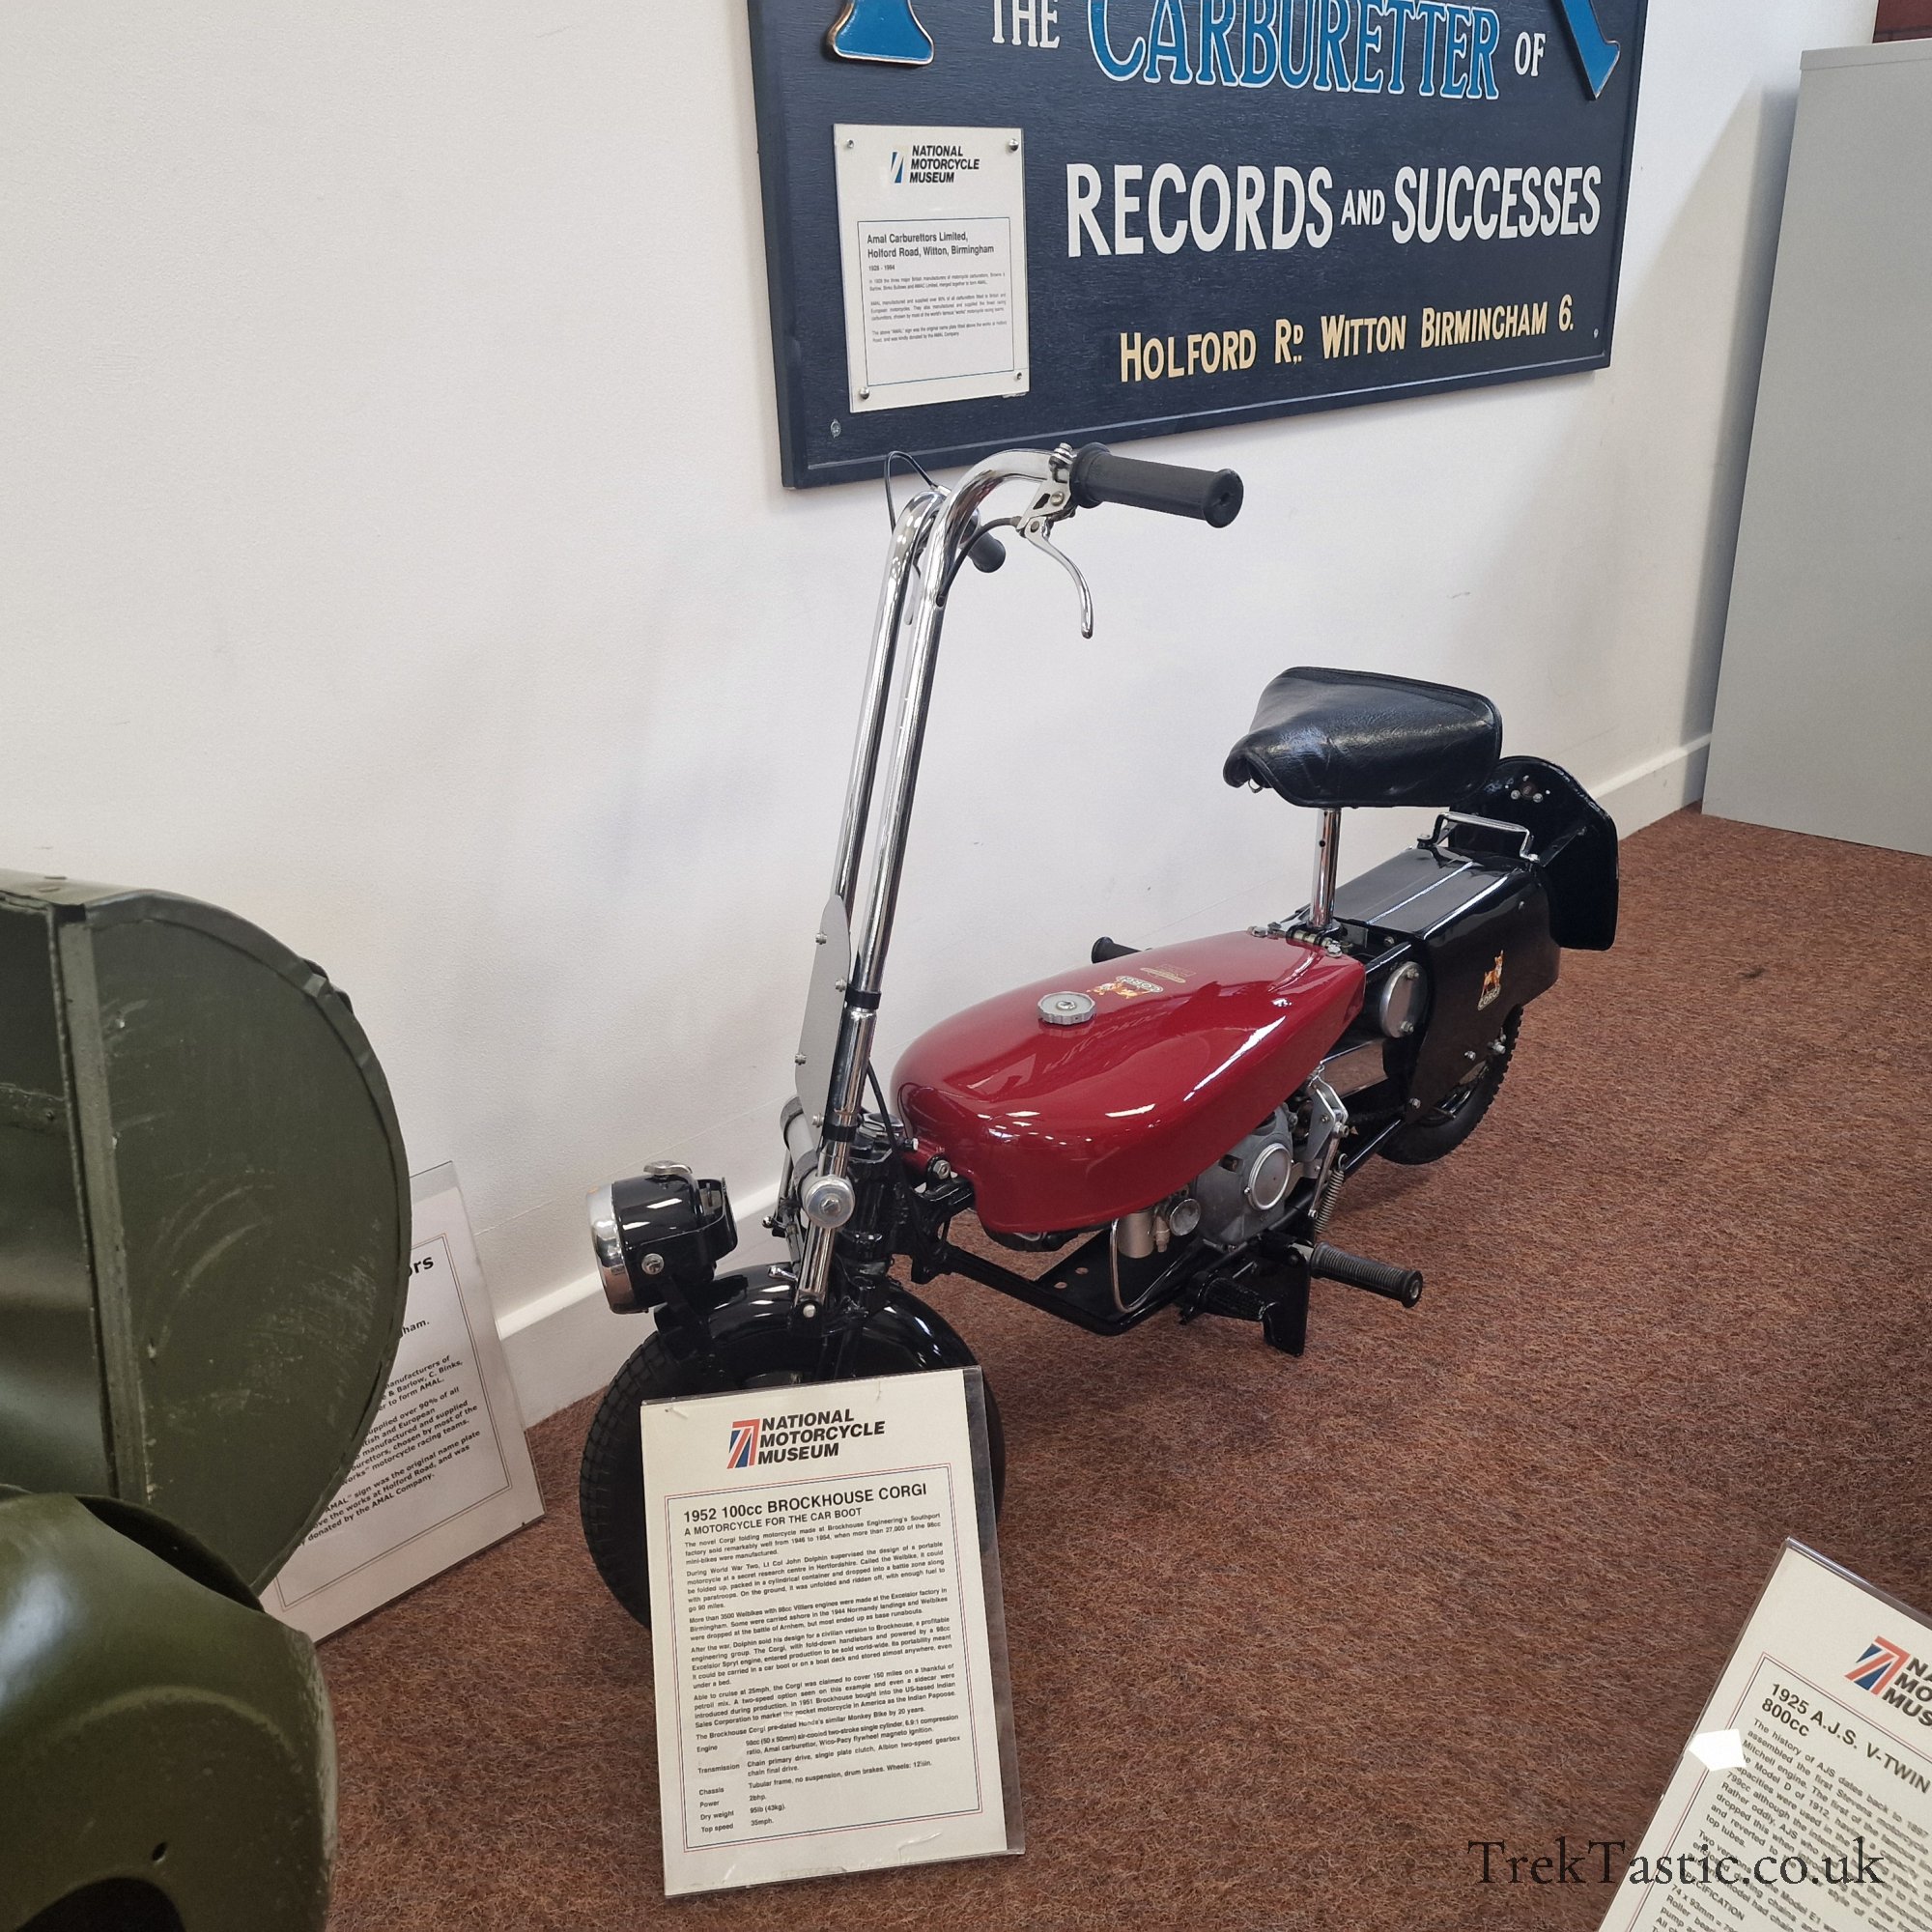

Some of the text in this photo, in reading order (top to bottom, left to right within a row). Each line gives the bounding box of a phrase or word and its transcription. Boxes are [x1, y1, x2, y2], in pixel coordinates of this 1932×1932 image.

[1087, 0, 1499, 100] CARBURETTER
[1514, 32, 1547, 77] OF
[912, 145, 964, 156] NATIONAL
[910, 158, 980, 170] MOTORCYCLE
[909, 172, 955, 184] MUSEUM
[1066, 162, 1603, 258] RECORDS AND SUCCESSES
[867, 231, 969, 244] Amal Carburettors Limited,
[867, 244, 995, 258] Holford Road, Witton, Birmingham
[1120, 328, 1257, 383] HOLFORD
[1321, 314, 1406, 359] WITTON
[1420, 301, 1548, 349] BIRMINGHAM
[1558, 294, 1575, 332] 6.
[369, 1416, 398, 1435] upplied
[762, 1408, 855, 1432] NATIONAL
[759, 1421, 885, 1448] MOTORCYCLE
[757, 1442, 839, 1465] MUSEUM
[683, 1482, 927, 1523] 1952 100cc BROCKHOUSE CORGI
[683, 1506, 863, 1537] A MOTORCYCLE FOR THE CAR BOOT
[1761, 1697, 1810, 1737] 800cc
[1771, 1683, 1932, 1794] 1925 A.J.S. V-TWIN
[696, 1745, 718, 1753] Engine
[696, 1763, 740, 1775] Transmission
[698, 1786, 724, 1796] Chassis
[698, 1800, 720, 1808] Power
[699, 1809, 734, 1822] Dry weight
[714, 1822, 734, 1833] speed
